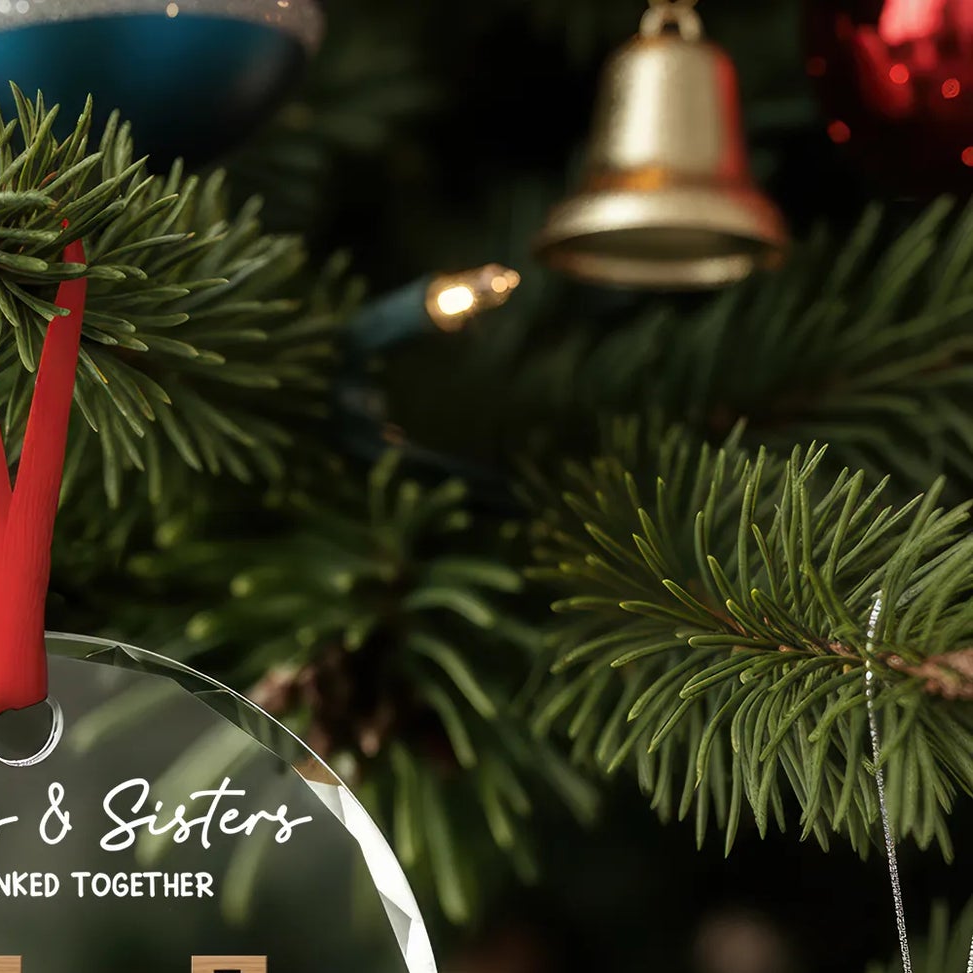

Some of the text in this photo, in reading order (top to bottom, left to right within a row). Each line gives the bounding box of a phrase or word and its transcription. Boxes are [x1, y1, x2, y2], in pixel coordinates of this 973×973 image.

[39, 782, 73, 845] &
[99, 776, 313, 851] Sisters
[70, 872, 214, 898] TOGETHER
